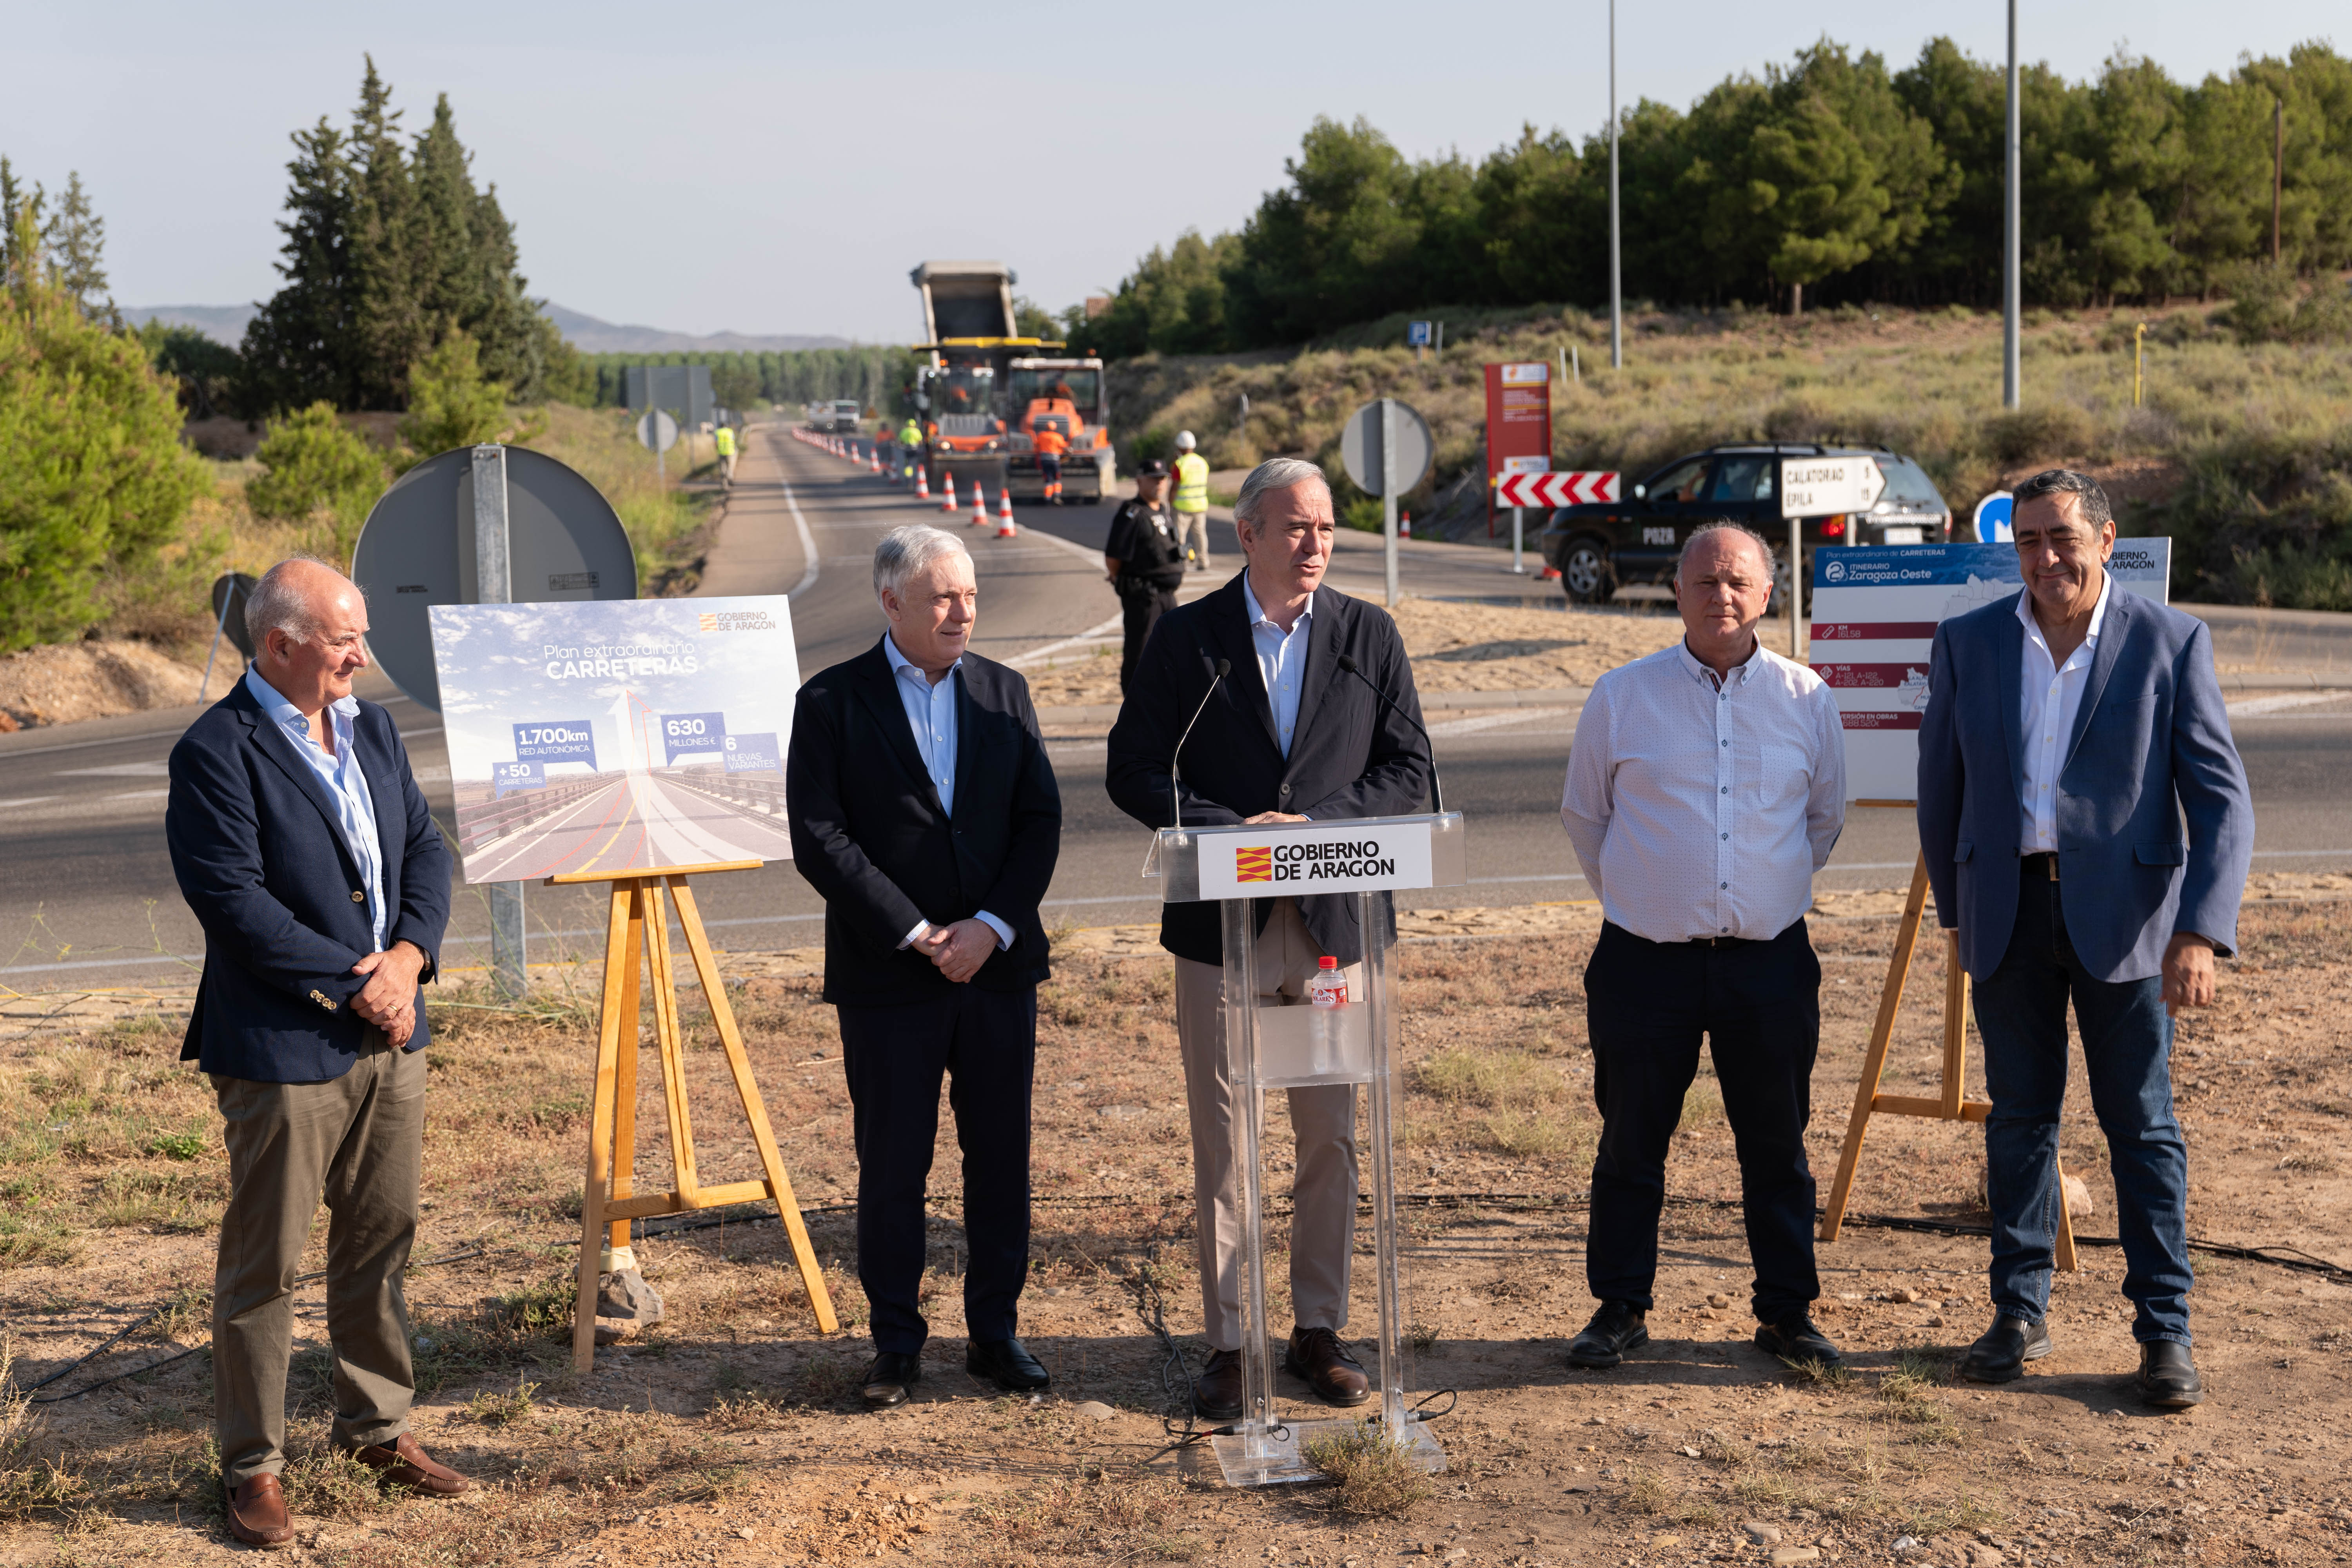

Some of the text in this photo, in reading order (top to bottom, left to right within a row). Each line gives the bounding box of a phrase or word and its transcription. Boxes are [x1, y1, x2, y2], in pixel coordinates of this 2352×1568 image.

[1864, 465, 1871, 479] 5
[1860, 487, 1871, 501] 15
[1900, 548, 1946, 557] CARRETERAS
[2109, 551, 2148, 560] BIERNO
[2112, 560, 2155, 570] ARAGON
[1849, 569, 1932, 583] Zaragoza Oeste
[717, 612, 767, 621] GOBIERNO
[719, 621, 776, 631] DE ARAGON
[544, 641, 695, 659] Plan extraordinario
[546, 656, 698, 679] CARRETERAS
[667, 719, 705, 736] 630
[519, 728, 588, 745] 1.700km
[669, 737, 716, 747] MILLONES €
[537, 744, 590, 755] AUTONÓMICA
[725, 737, 737, 751] 6
[727, 752, 762, 762] NUEVAS
[728, 759, 776, 769] VARIANTES
[499, 777, 543, 786] CARRETERAS
[1274, 841, 1379, 862] GOBIERNO
[1274, 858, 1394, 881] DE ARAGON
